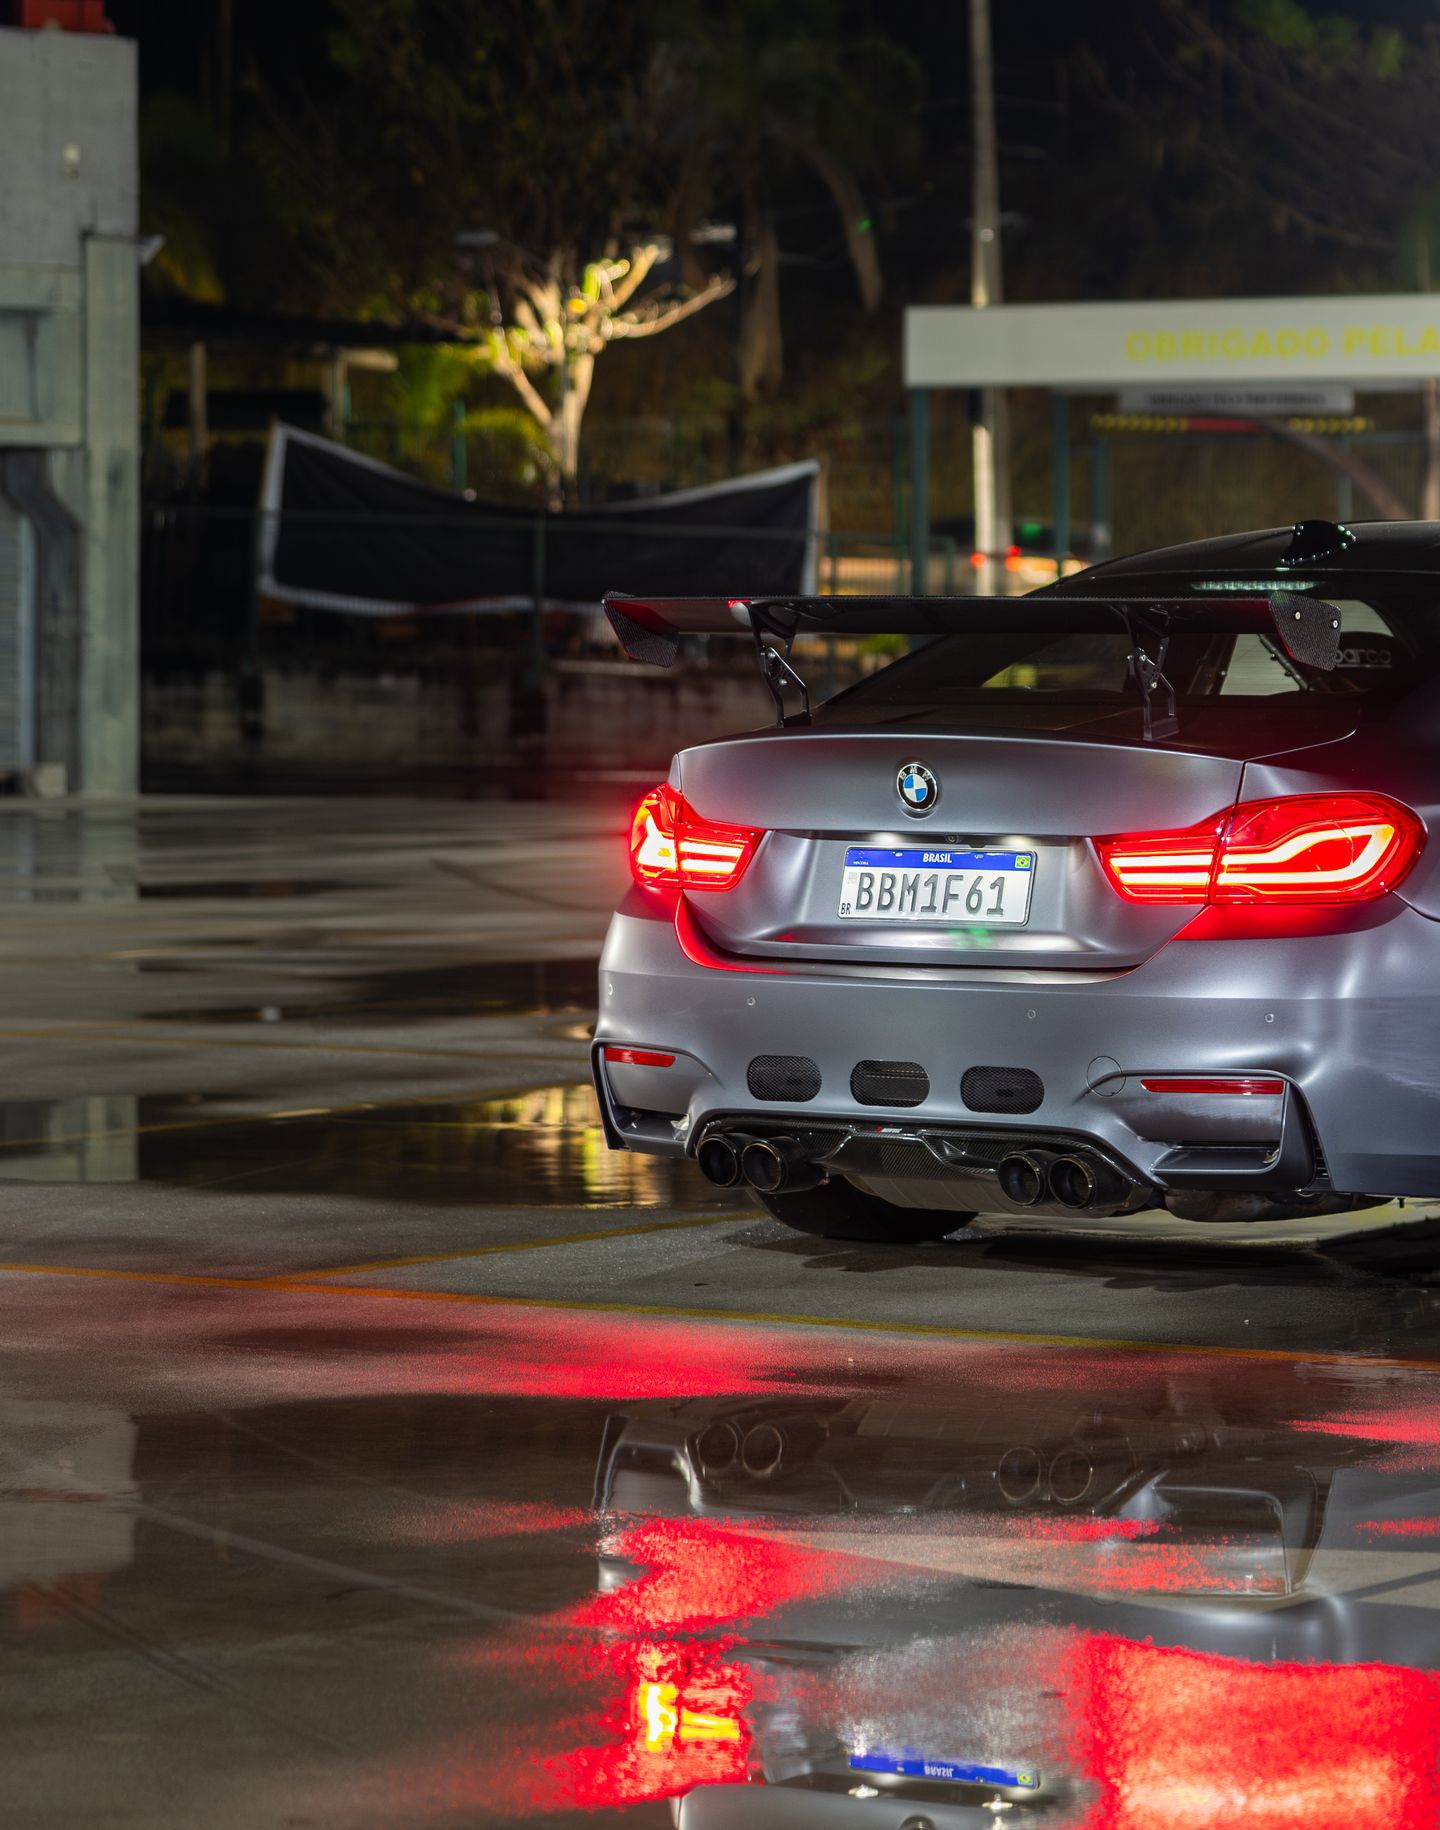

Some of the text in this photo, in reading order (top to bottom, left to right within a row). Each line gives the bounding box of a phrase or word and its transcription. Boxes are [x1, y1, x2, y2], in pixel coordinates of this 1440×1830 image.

[1125, 327, 1330, 362] OBRIGADO
[1334, 649, 1391, 663] parco
[922, 853, 952, 864] BRASIL
[855, 872, 1005, 916] BBM1F61
[840, 902, 851, 915] BR
